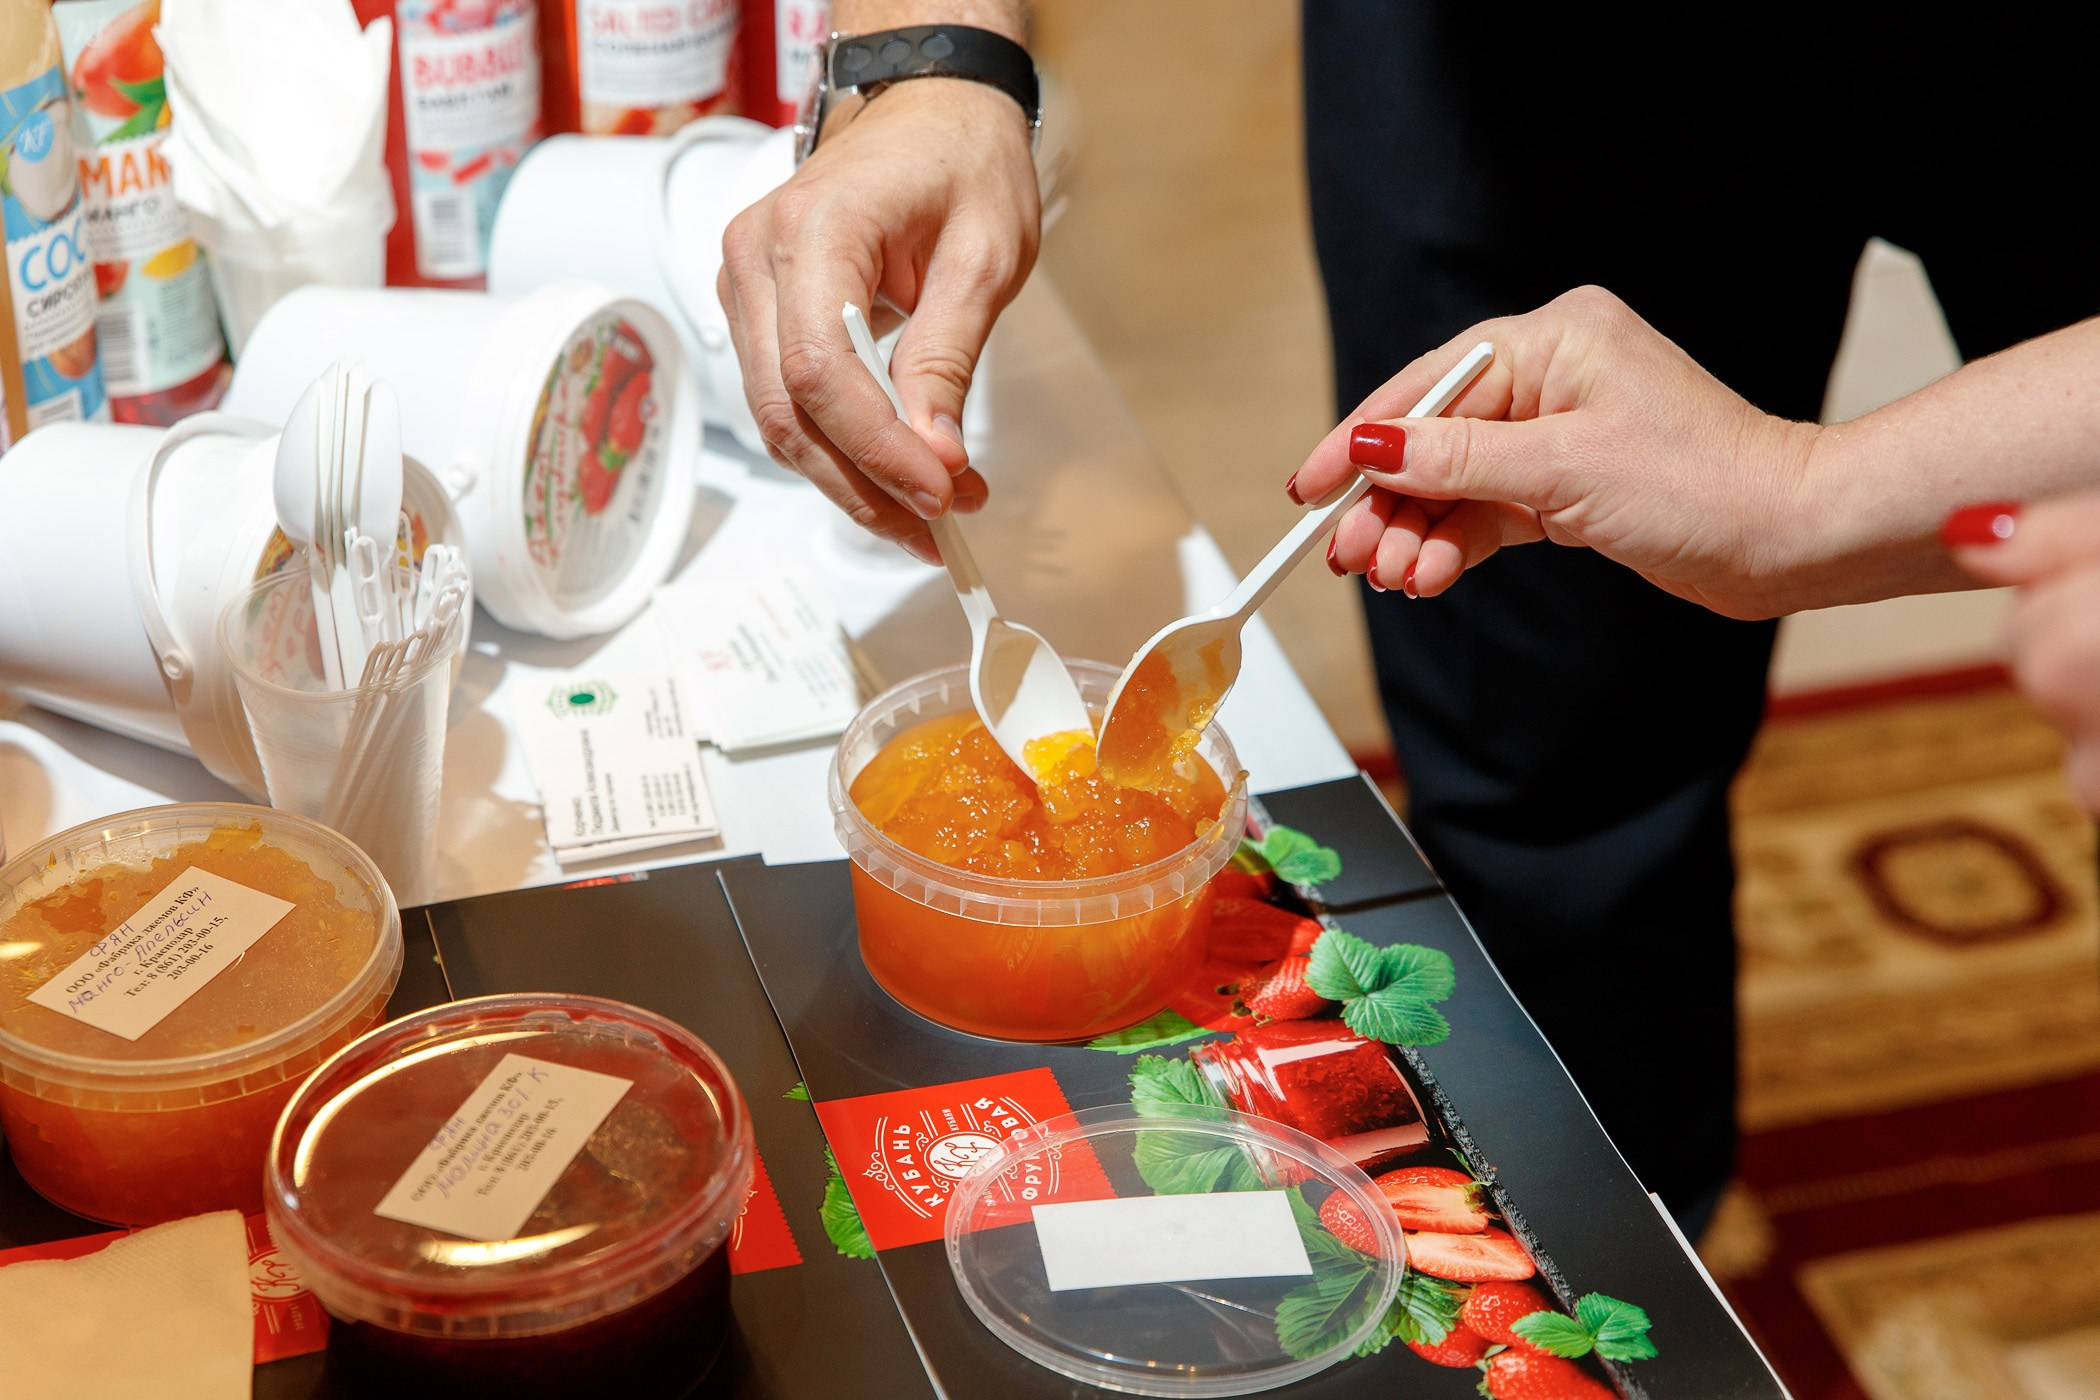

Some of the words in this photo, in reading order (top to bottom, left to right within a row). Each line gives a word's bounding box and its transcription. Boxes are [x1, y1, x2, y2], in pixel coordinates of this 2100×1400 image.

[66, 972, 95, 994] ООО
[96, 934, 141, 972] «Фабрика
[144, 904, 178, 936] джемов
[139, 926, 194, 970] Краснодар
[156, 953, 182, 977] (861)
[166, 943, 214, 981] 203-00-16
[941, 1108, 960, 1132] КУБАНИ
[892, 1124, 945, 1208] КУБАНЬ
